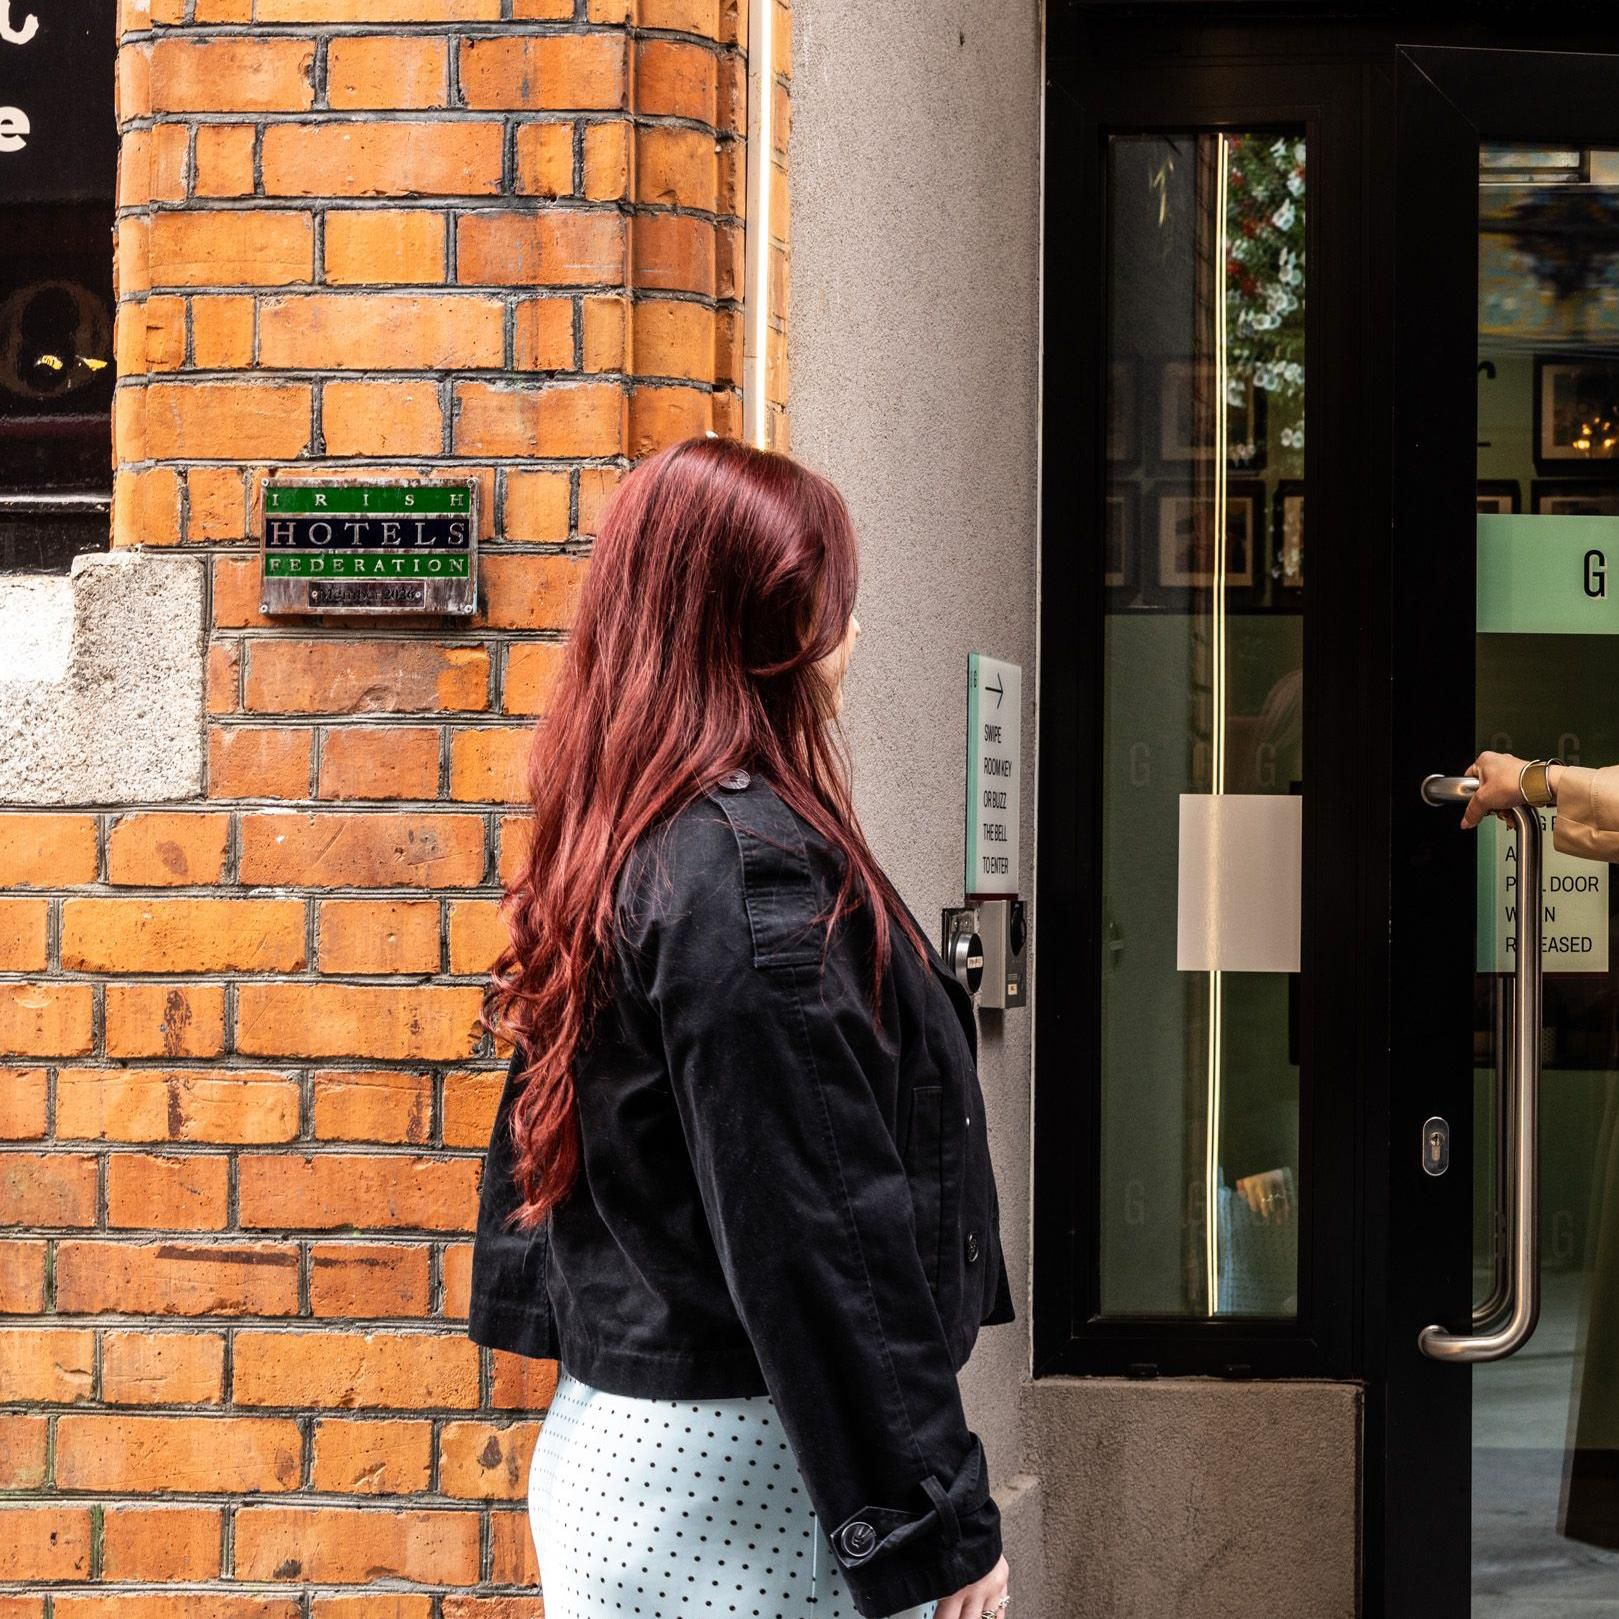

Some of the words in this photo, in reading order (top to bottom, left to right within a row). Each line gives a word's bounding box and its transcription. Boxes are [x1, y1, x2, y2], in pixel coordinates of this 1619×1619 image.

[272, 493, 464, 506] IRISH
[270, 522, 465, 546] HOTELS
[270, 558, 464, 573] FEDERATION
[1584, 549, 1605, 598] G
[984, 724, 1002, 744] SWIPE
[984, 757, 1001, 777] ROOM
[1001, 759, 1012, 778] KEY
[983, 790, 992, 808] OR
[992, 791, 1007, 810] BUZZ
[983, 823, 994, 841] THE
[994, 824, 1008, 842] BELL
[983, 856, 990, 874] TO
[991, 857, 1009, 874] ENTER
[1550, 876, 1599, 892] DOOR
[1505, 906, 1555, 922] WN
[1506, 936, 1592, 952] REASED
